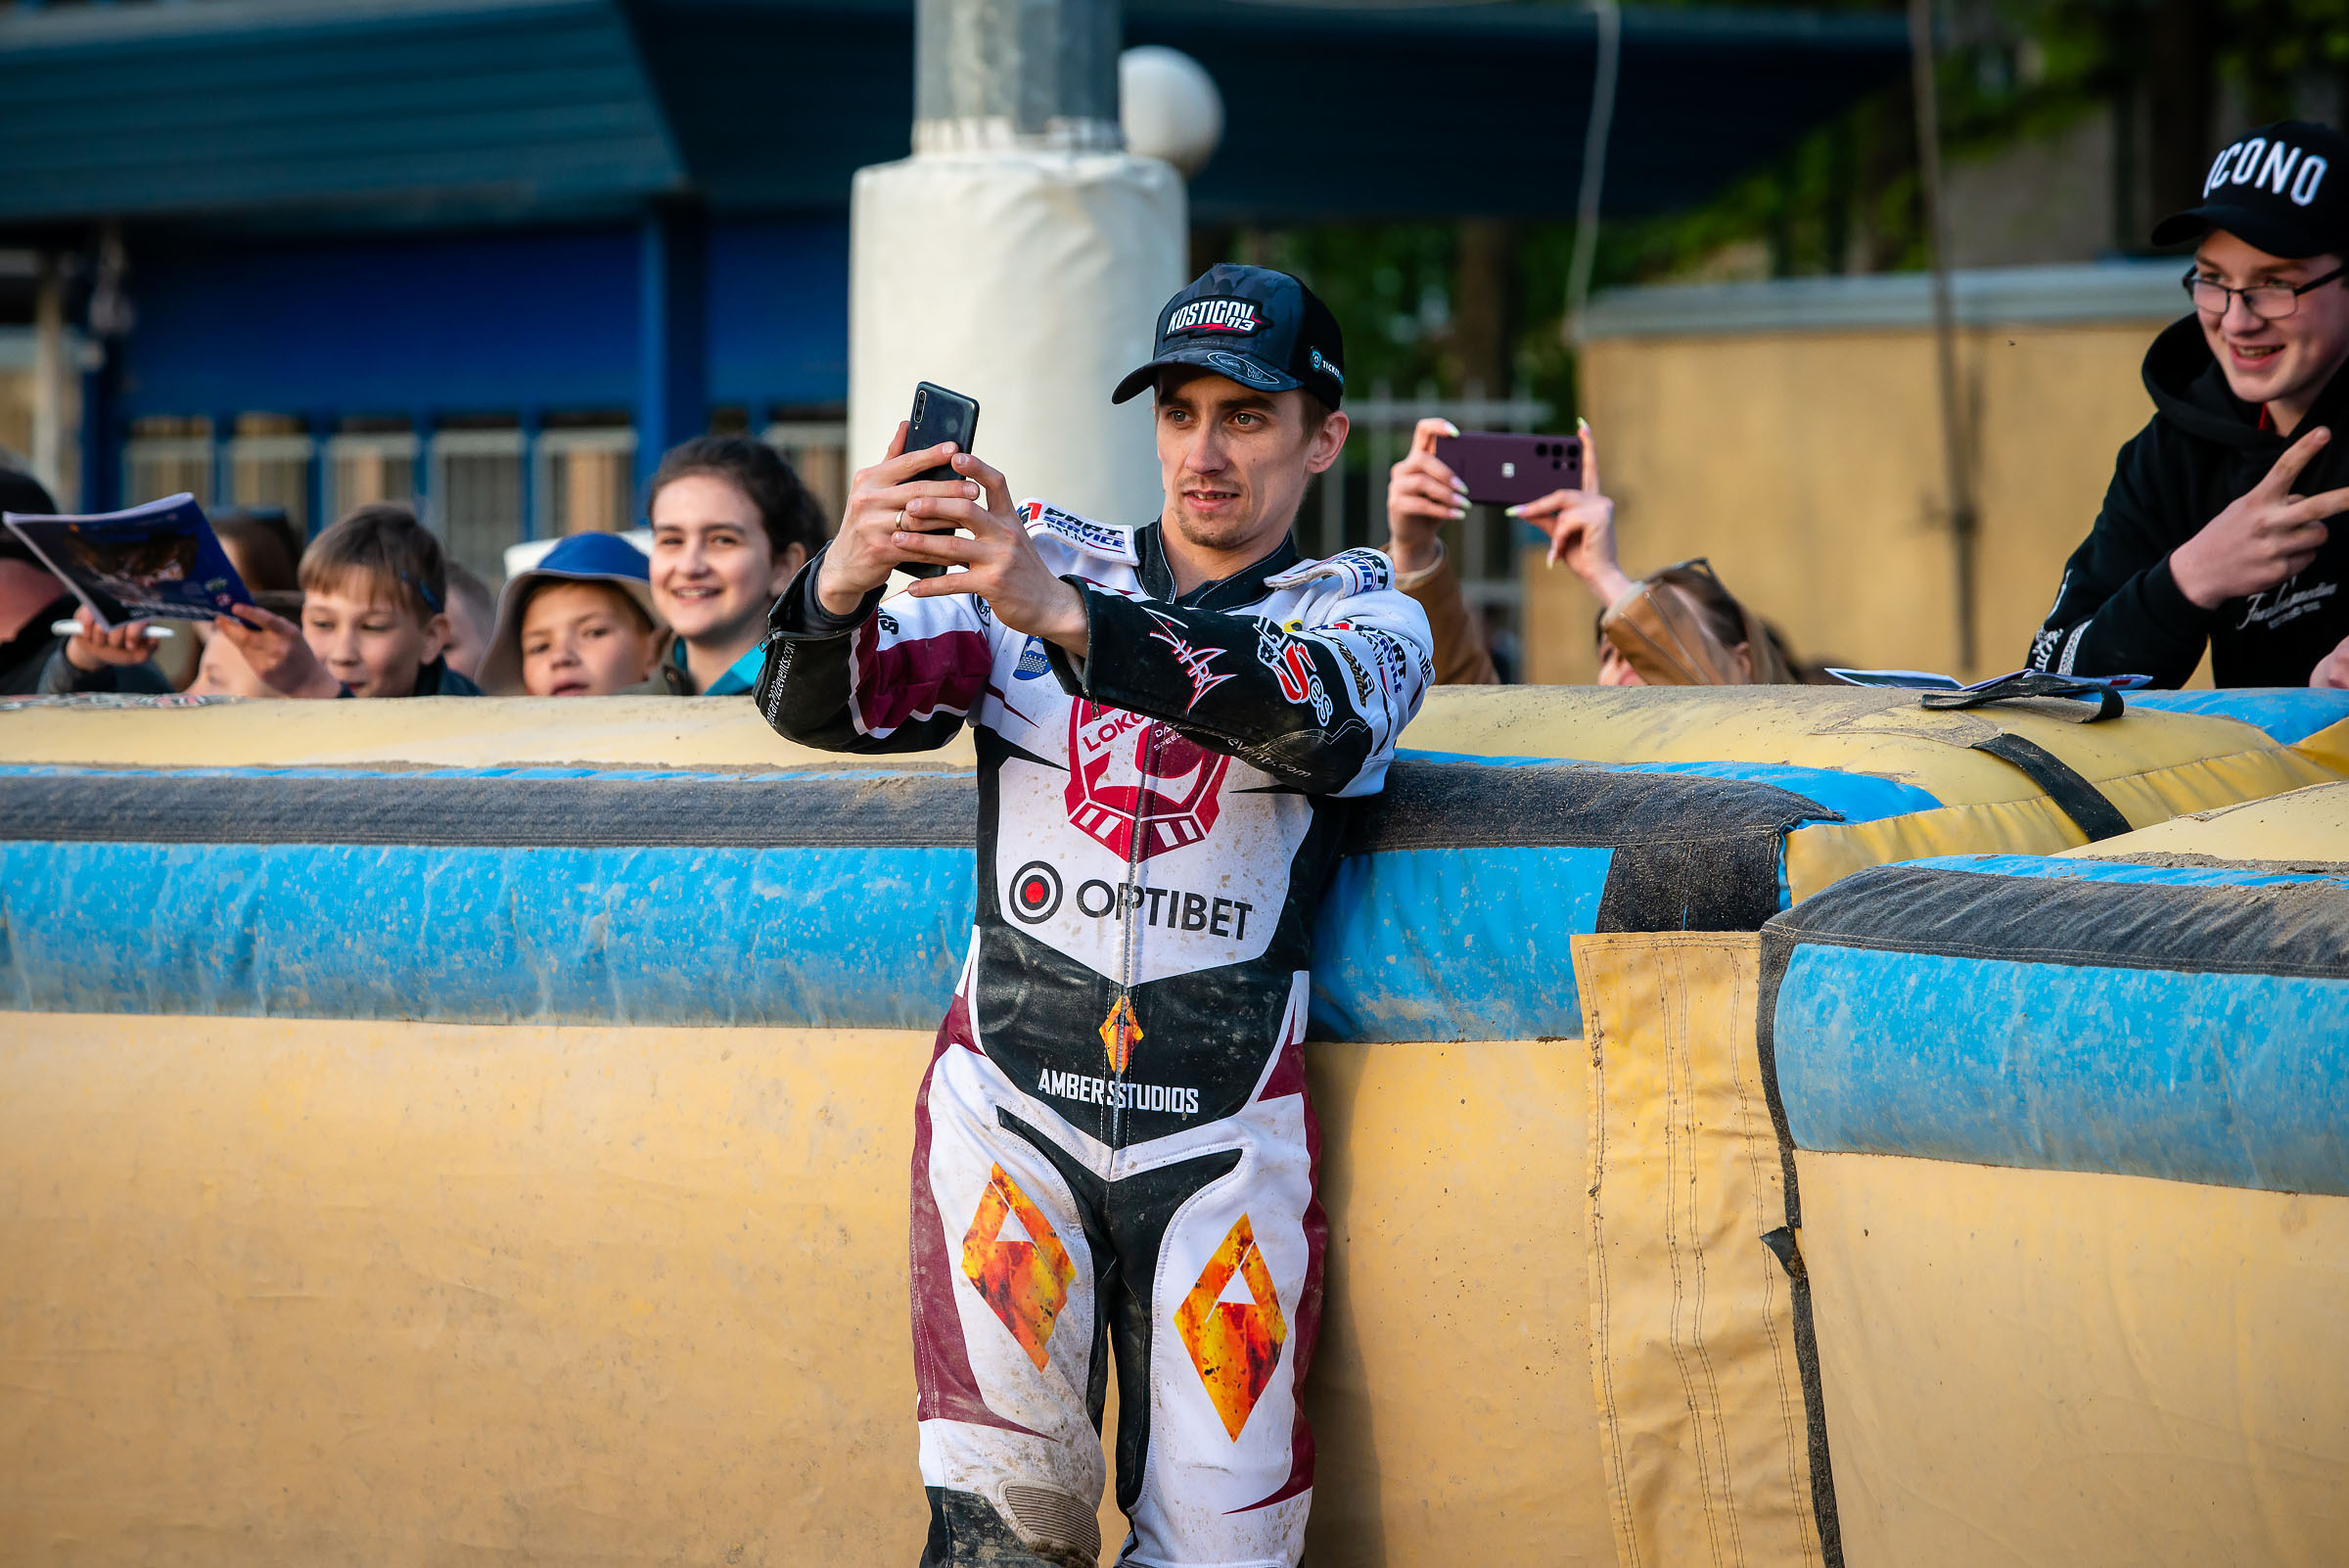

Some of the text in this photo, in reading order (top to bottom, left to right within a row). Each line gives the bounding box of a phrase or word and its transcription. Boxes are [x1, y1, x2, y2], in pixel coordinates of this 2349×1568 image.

[1166, 300, 1255, 335] KOSTIGOV
[1225, 316, 1256, 332] 113
[1042, 515, 1126, 548] SERVICE
[1043, 506, 1125, 537] PART
[1076, 878, 1254, 942] OPTIBET
